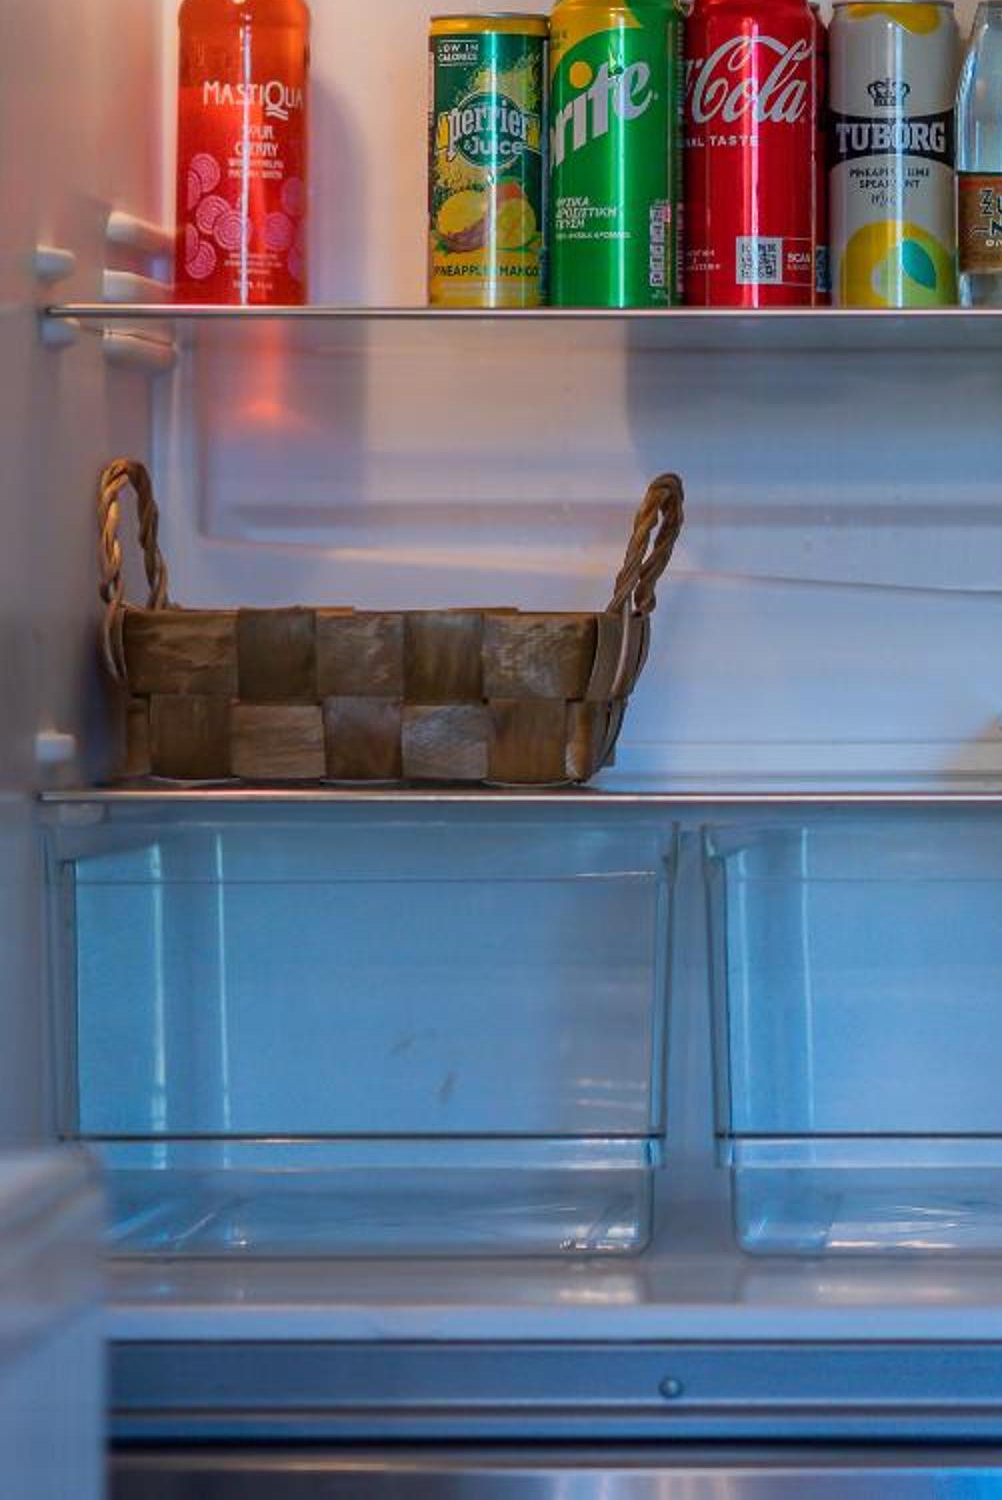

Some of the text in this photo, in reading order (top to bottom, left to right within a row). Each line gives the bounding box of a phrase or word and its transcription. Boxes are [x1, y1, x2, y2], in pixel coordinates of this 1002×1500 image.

[550, 61, 653, 174] rite
[692, 35, 812, 124] Cola
[835, 122, 946, 155] TUBORG
